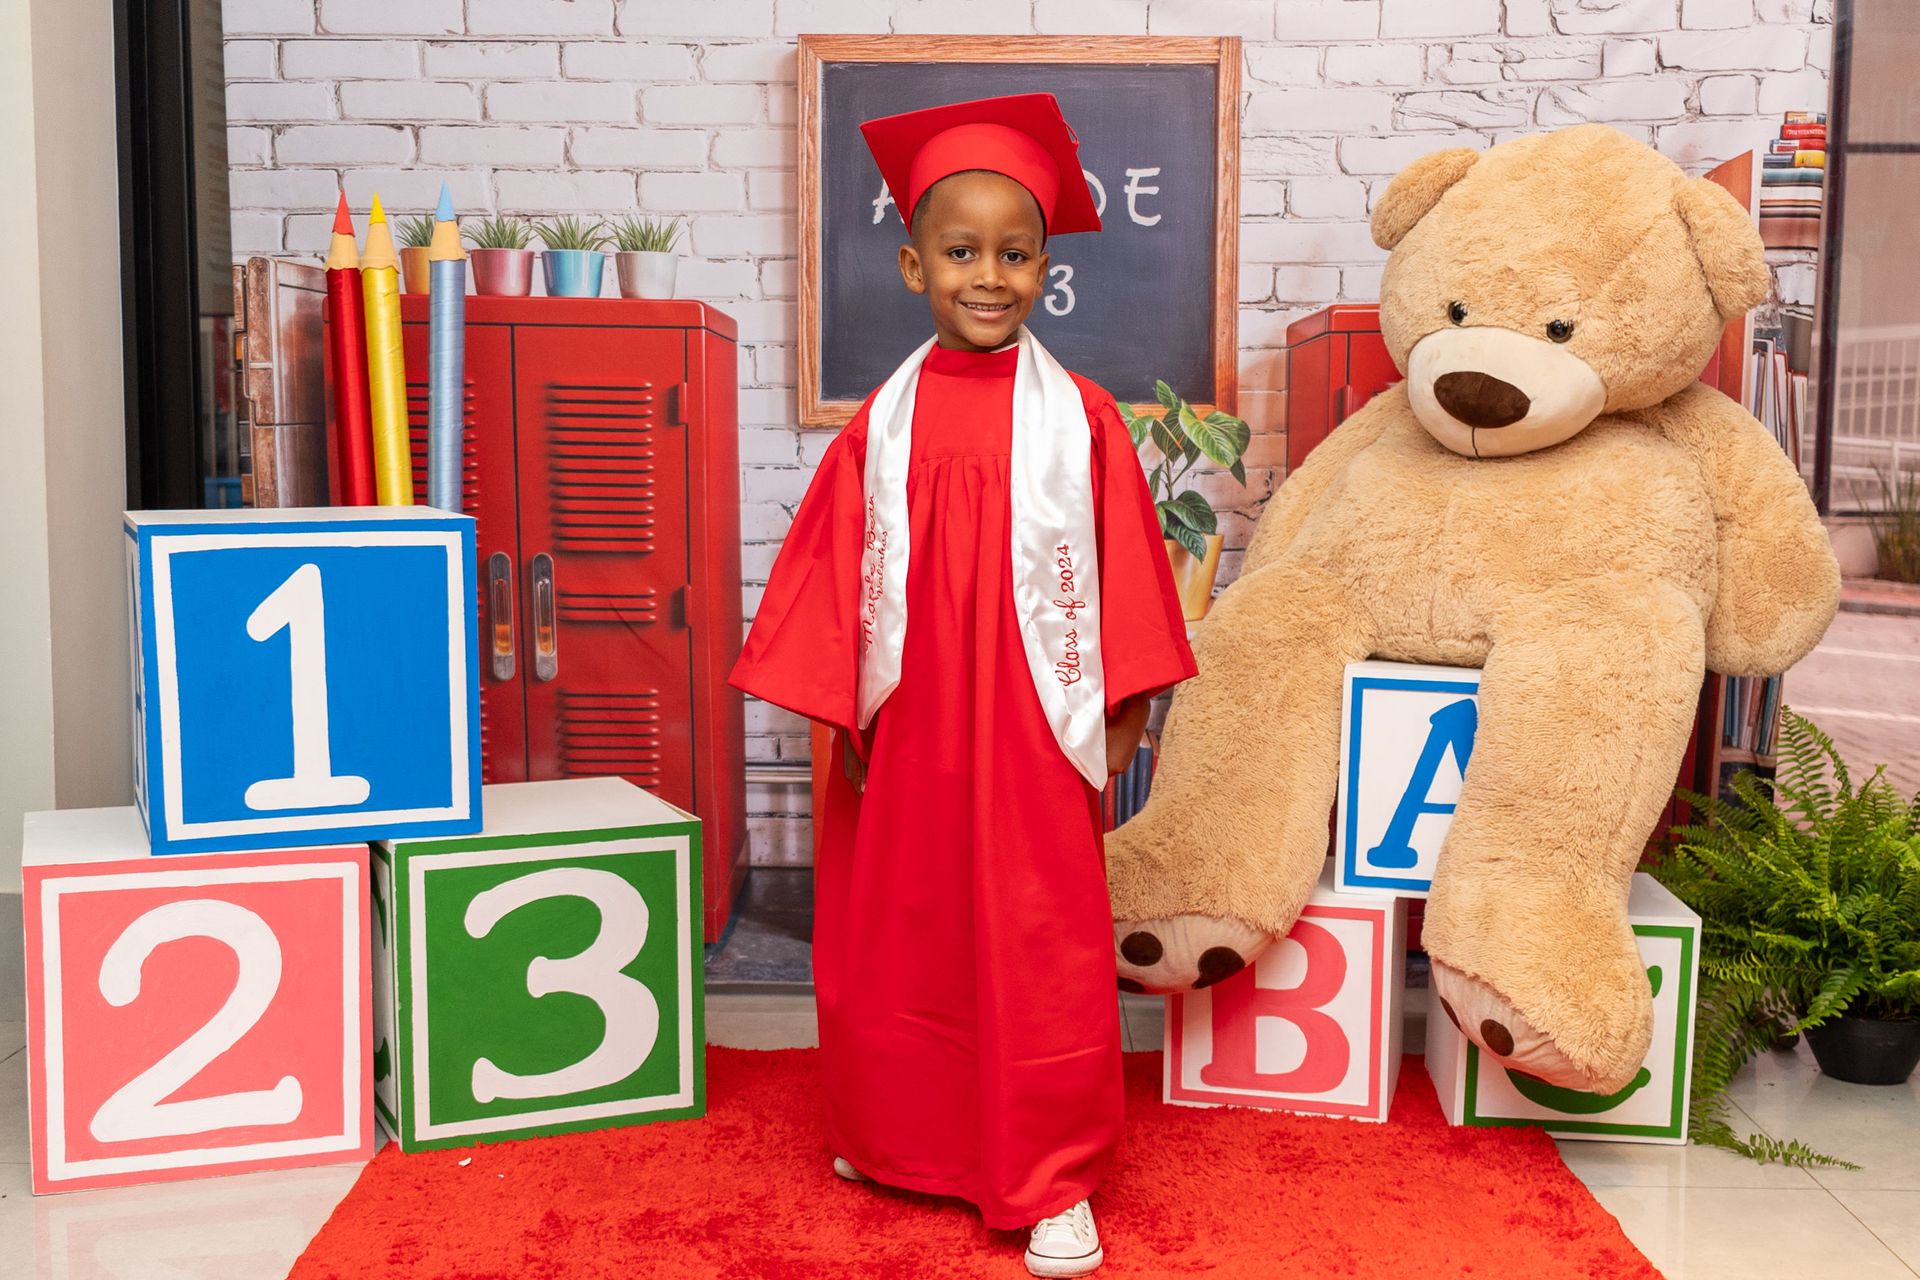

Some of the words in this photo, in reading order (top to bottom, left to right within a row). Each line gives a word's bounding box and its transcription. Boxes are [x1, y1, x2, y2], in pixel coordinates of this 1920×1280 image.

[1044, 265, 1076, 316] 3
[866, 493, 877, 551] Bean
[862, 563, 879, 654] Maple
[1053, 597, 1086, 620] of
[1057, 544, 1075, 592] 2024
[245, 563, 370, 811] 1
[1055, 628, 1081, 687] Class
[1367, 698, 1478, 869] A
[91, 899, 303, 1143] 2
[465, 867, 660, 1104] 3
[1200, 922, 1350, 1093] B
